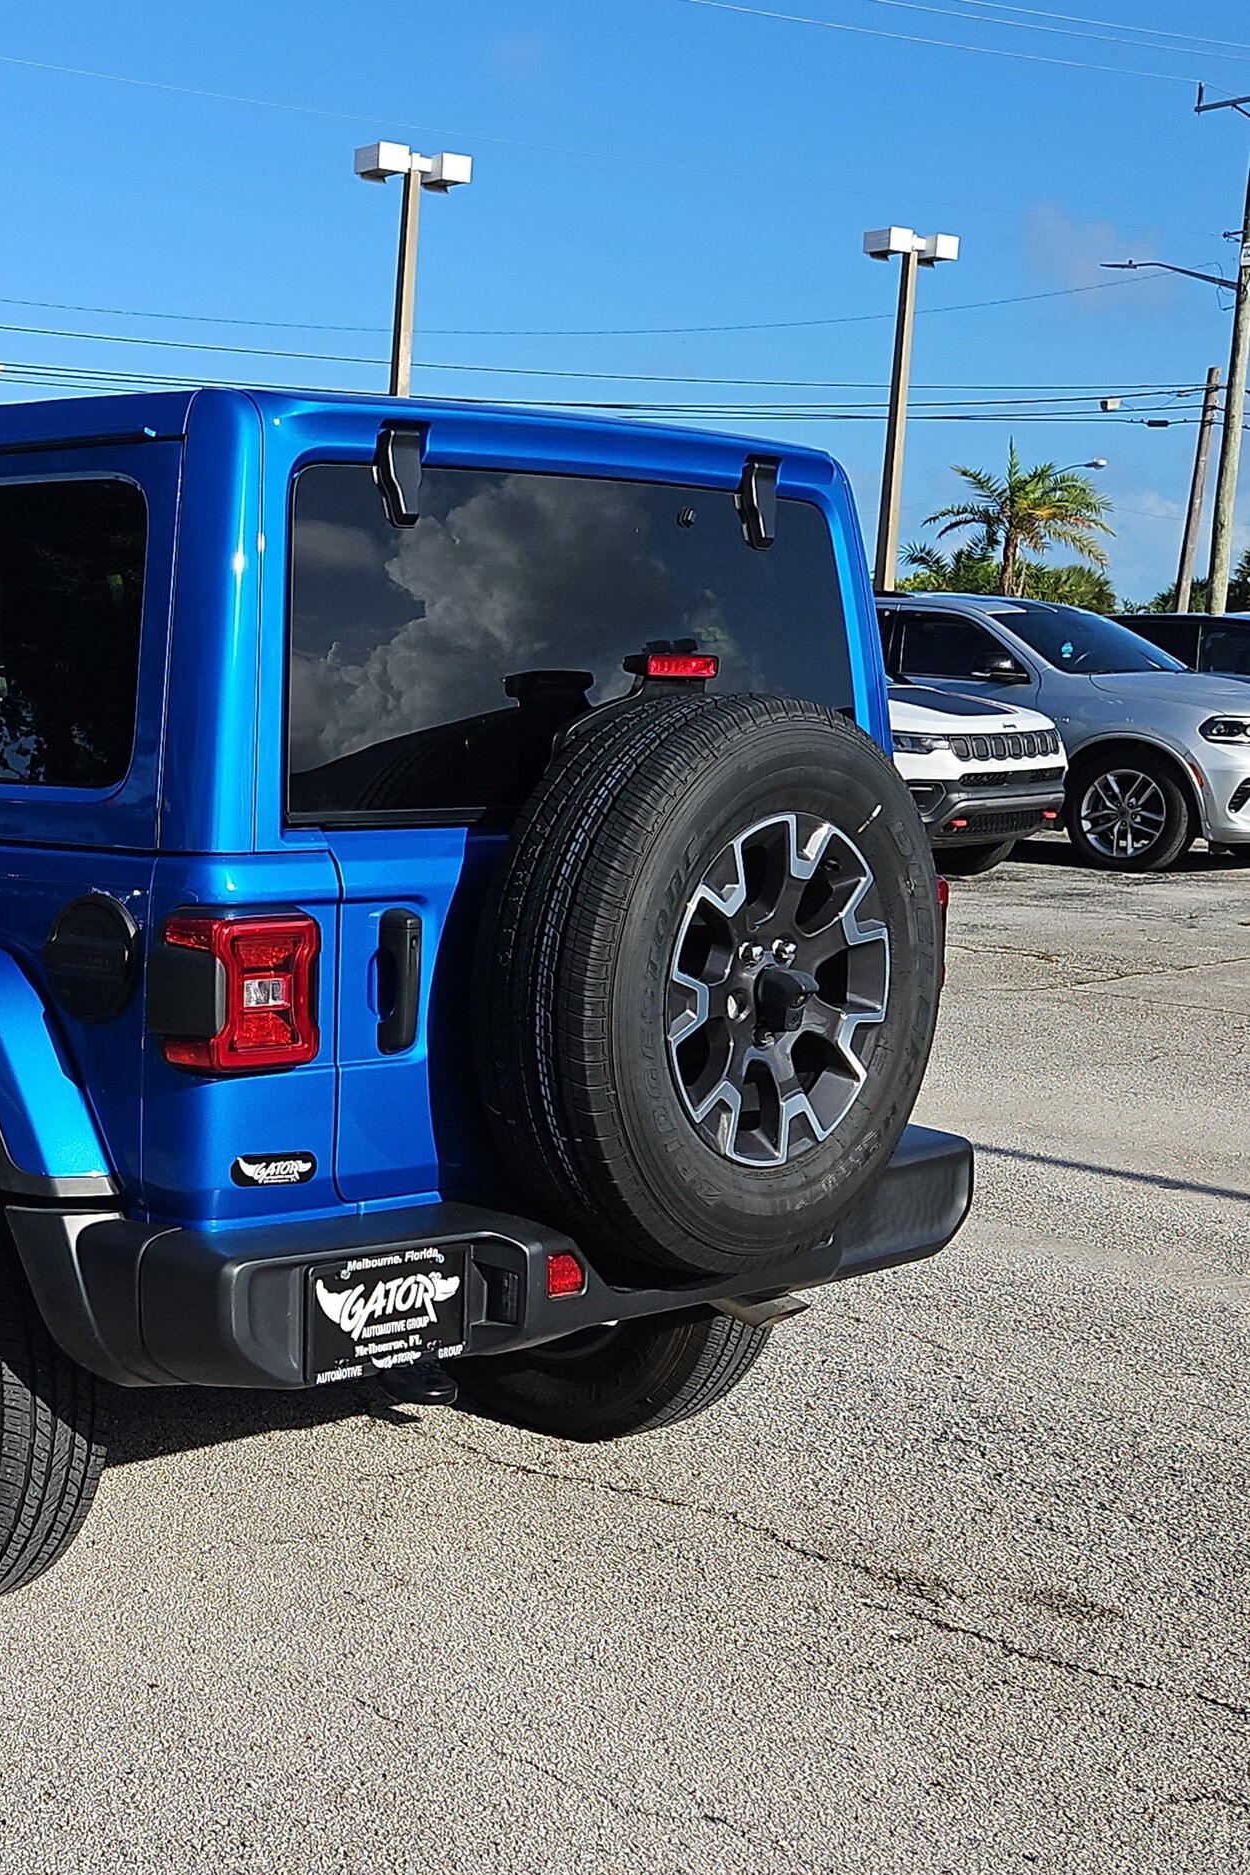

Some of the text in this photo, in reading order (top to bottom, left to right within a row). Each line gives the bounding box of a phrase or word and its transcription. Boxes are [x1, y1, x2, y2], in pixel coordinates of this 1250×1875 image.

[253, 1160, 300, 1184] GATOR
[346, 1247, 439, 1272] Melbourne, Florida
[340, 1273, 438, 1341] GATOR
[361, 1316, 430, 1339] AUTOMOTIVE GROUP
[354, 1334, 423, 1358] Melbourne, FL
[316, 1365, 363, 1385] AUTOMOTIVE
[437, 1344, 464, 1359] GROUP
